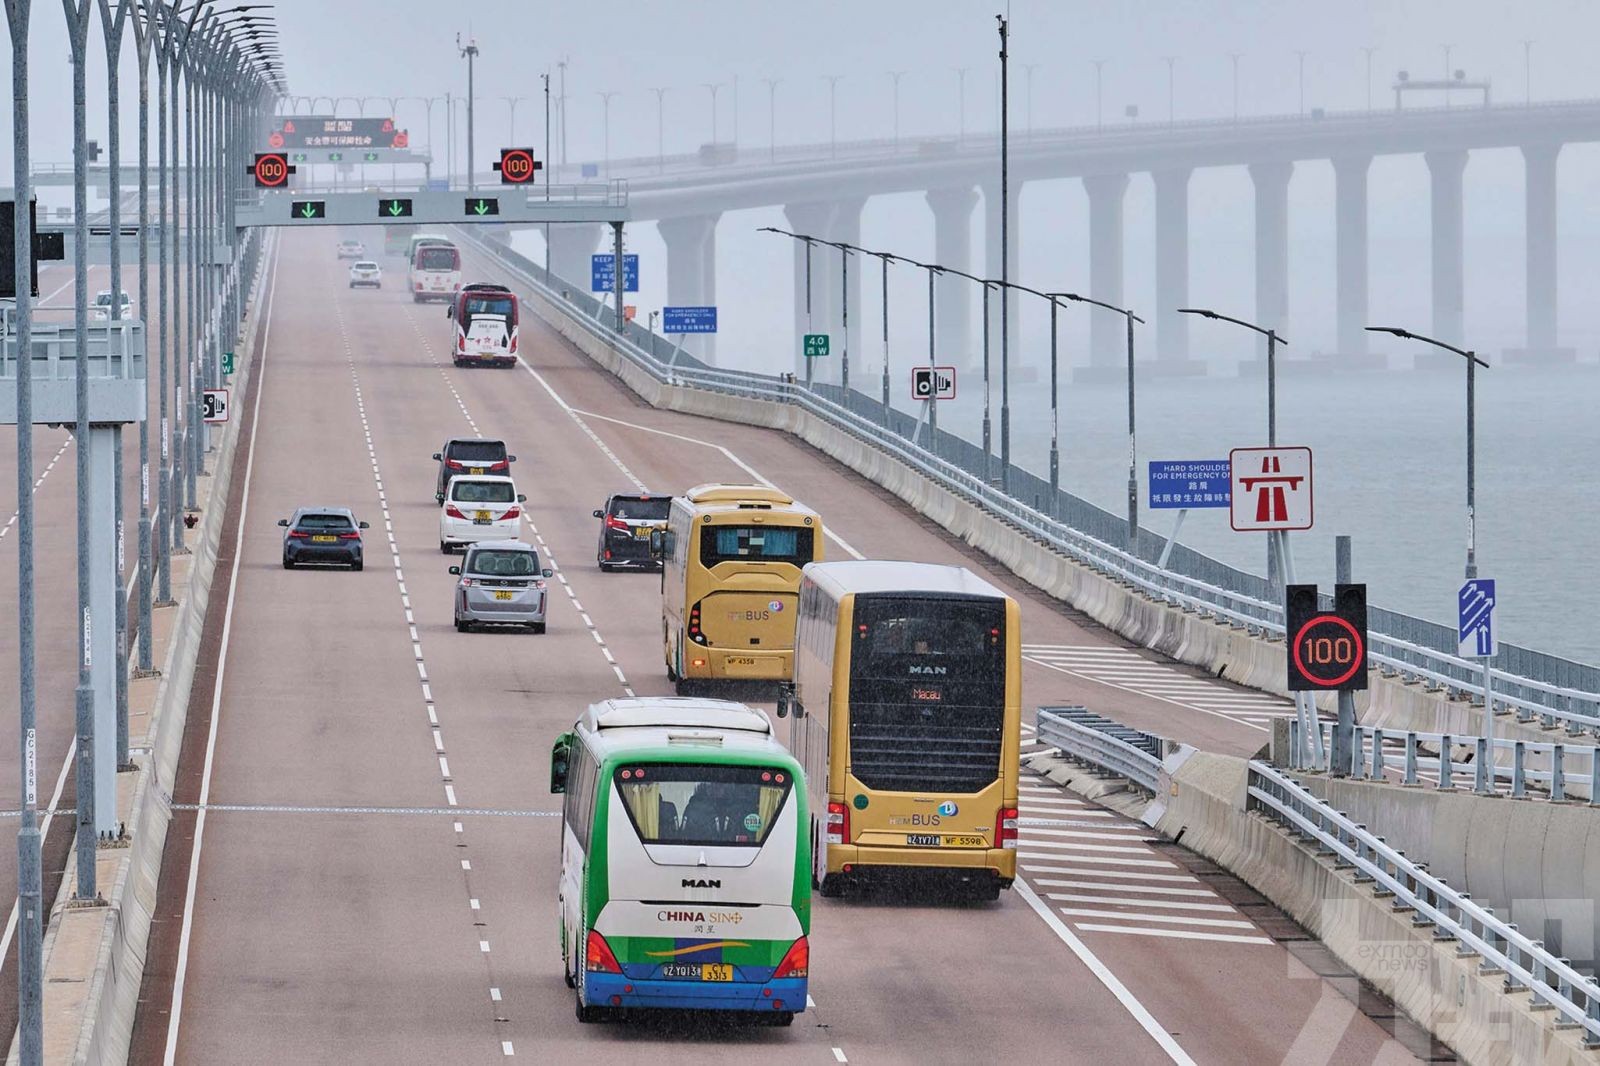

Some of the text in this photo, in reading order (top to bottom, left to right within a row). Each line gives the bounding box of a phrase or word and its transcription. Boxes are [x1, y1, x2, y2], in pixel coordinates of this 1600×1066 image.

[261, 163, 282, 177] 100
[507, 159, 528, 173] 100
[809, 336, 824, 346] 4.0
[1164, 464, 1186, 472] HARD
[1152, 472, 1169, 480] FOR
[1170, 471, 1220, 480] EMERGENCY
[1305, 637, 1352, 664] 100
[910, 666, 947, 674] MAN
[913, 688, 941, 700] Macau
[960, 837, 982, 846] 5598
[682, 879, 721, 888] MAN
[657, 910, 706, 922] CHINA
